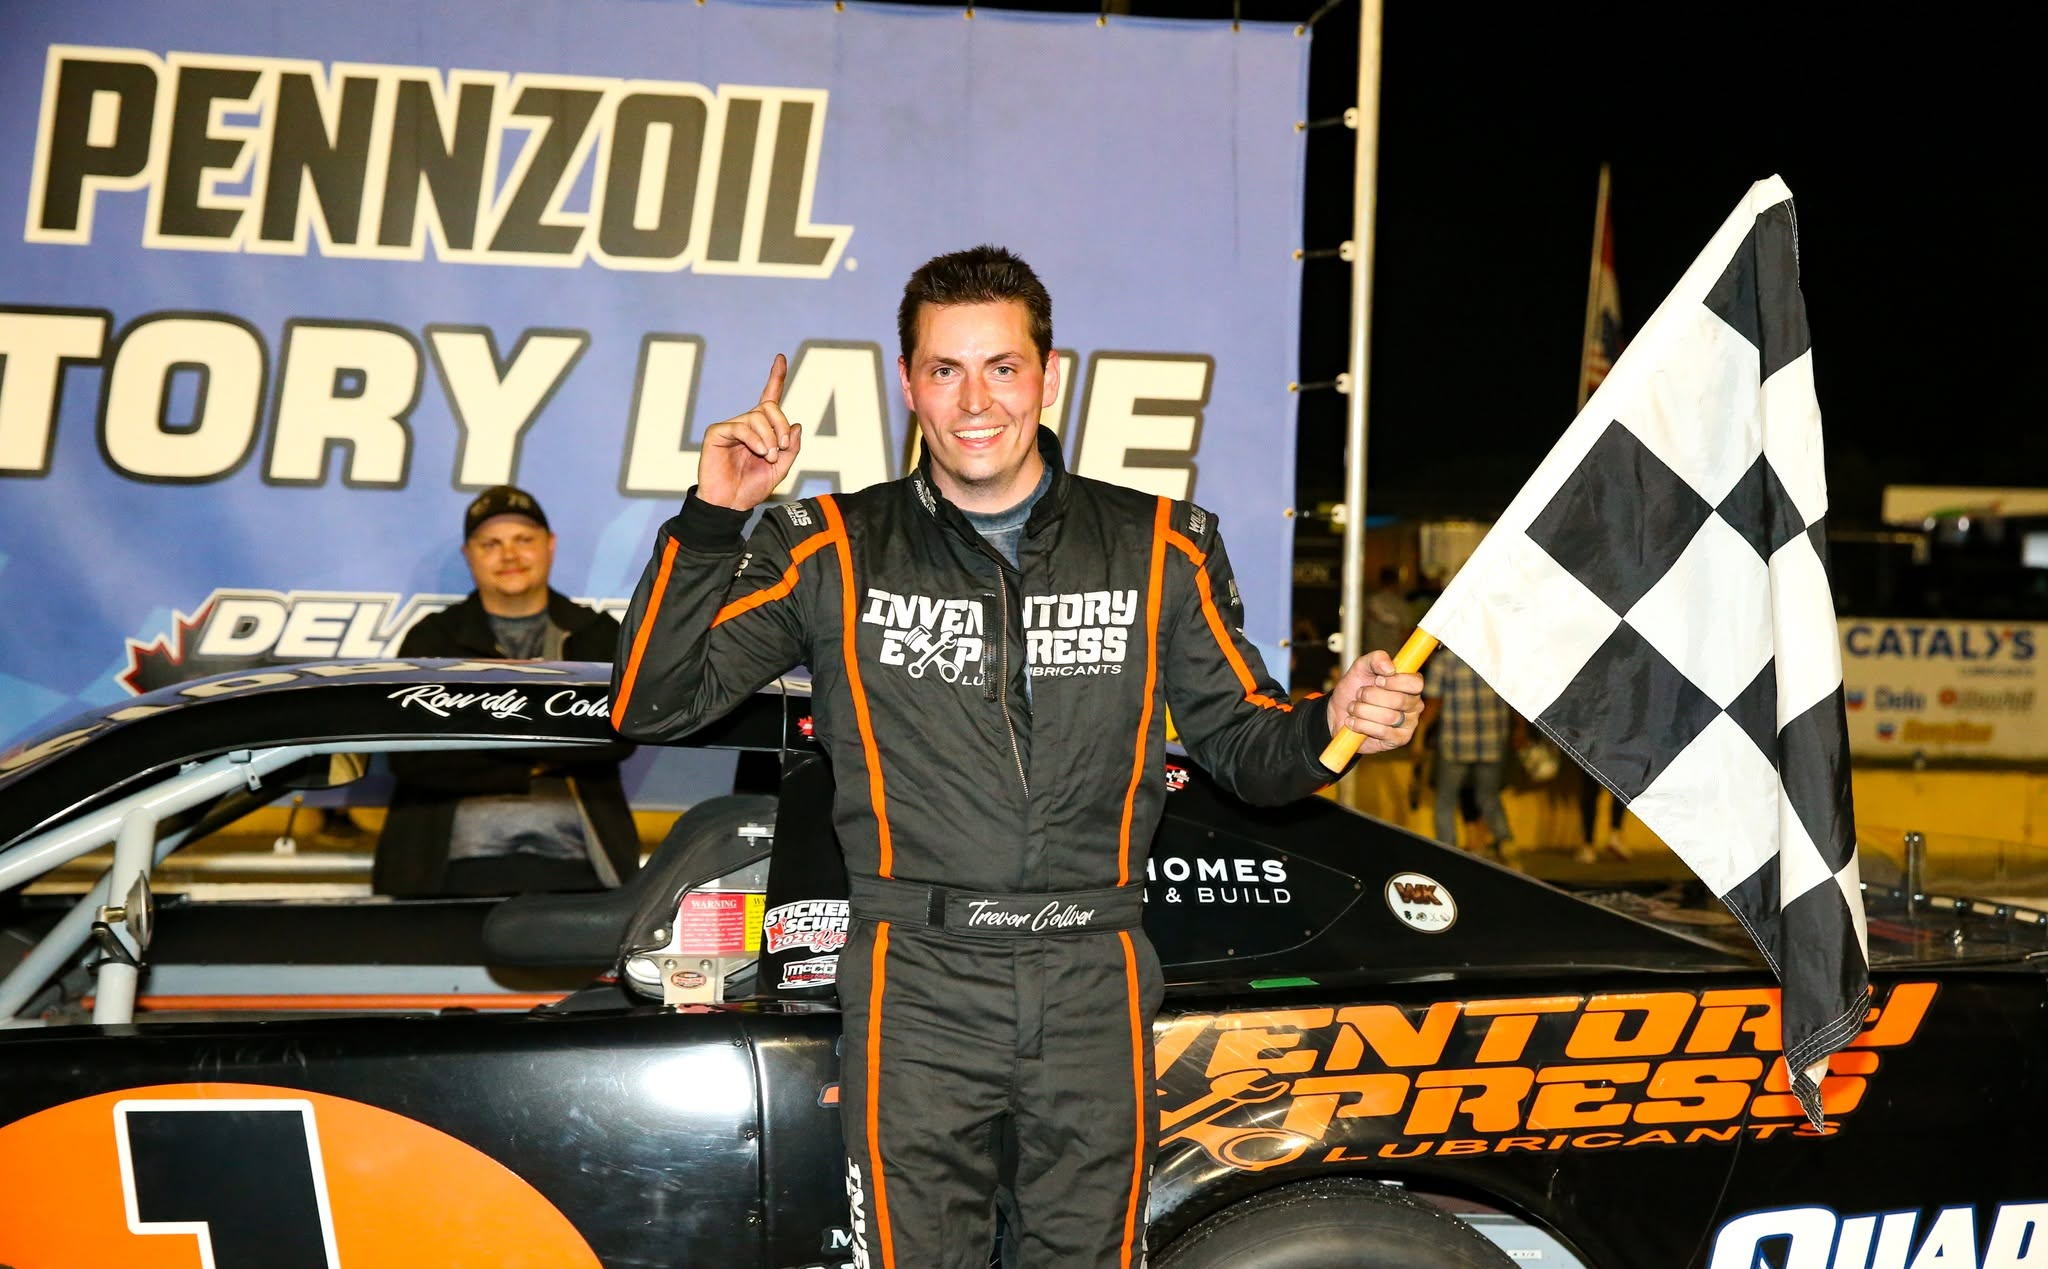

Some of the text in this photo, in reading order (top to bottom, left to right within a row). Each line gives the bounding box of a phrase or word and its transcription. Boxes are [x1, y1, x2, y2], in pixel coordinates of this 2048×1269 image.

[26, 45, 854, 278] PENNZOIL
[387, 684, 611, 720] Rowdy Coll
[691, 900, 737, 908] WARNING
[1165, 887, 1182, 903] &
[1198, 887, 1291, 903] BUILD
[969, 900, 1031, 927] Trevor
[776, 932, 815, 947] 2026
[1322, 1120, 1841, 1163] LUBRICANTS
[113, 1098, 342, 1269] 1
